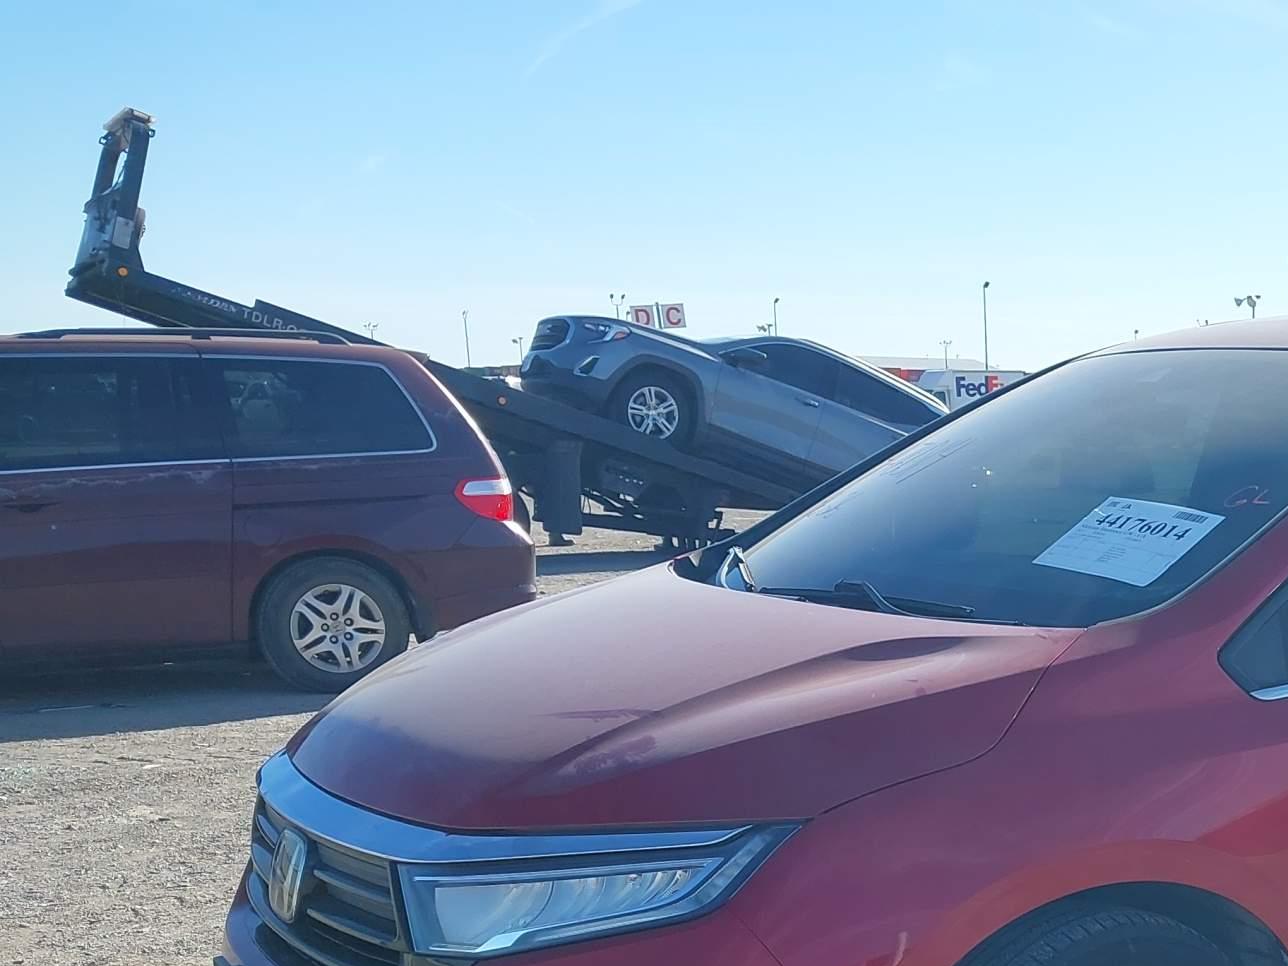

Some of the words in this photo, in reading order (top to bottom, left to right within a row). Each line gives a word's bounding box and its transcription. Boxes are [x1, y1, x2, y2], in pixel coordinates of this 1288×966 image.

[634, 308, 650, 325] D
[665, 306, 682, 325] C
[955, 375, 1002, 398] FedE
[1095, 512, 1192, 541] 44176014
